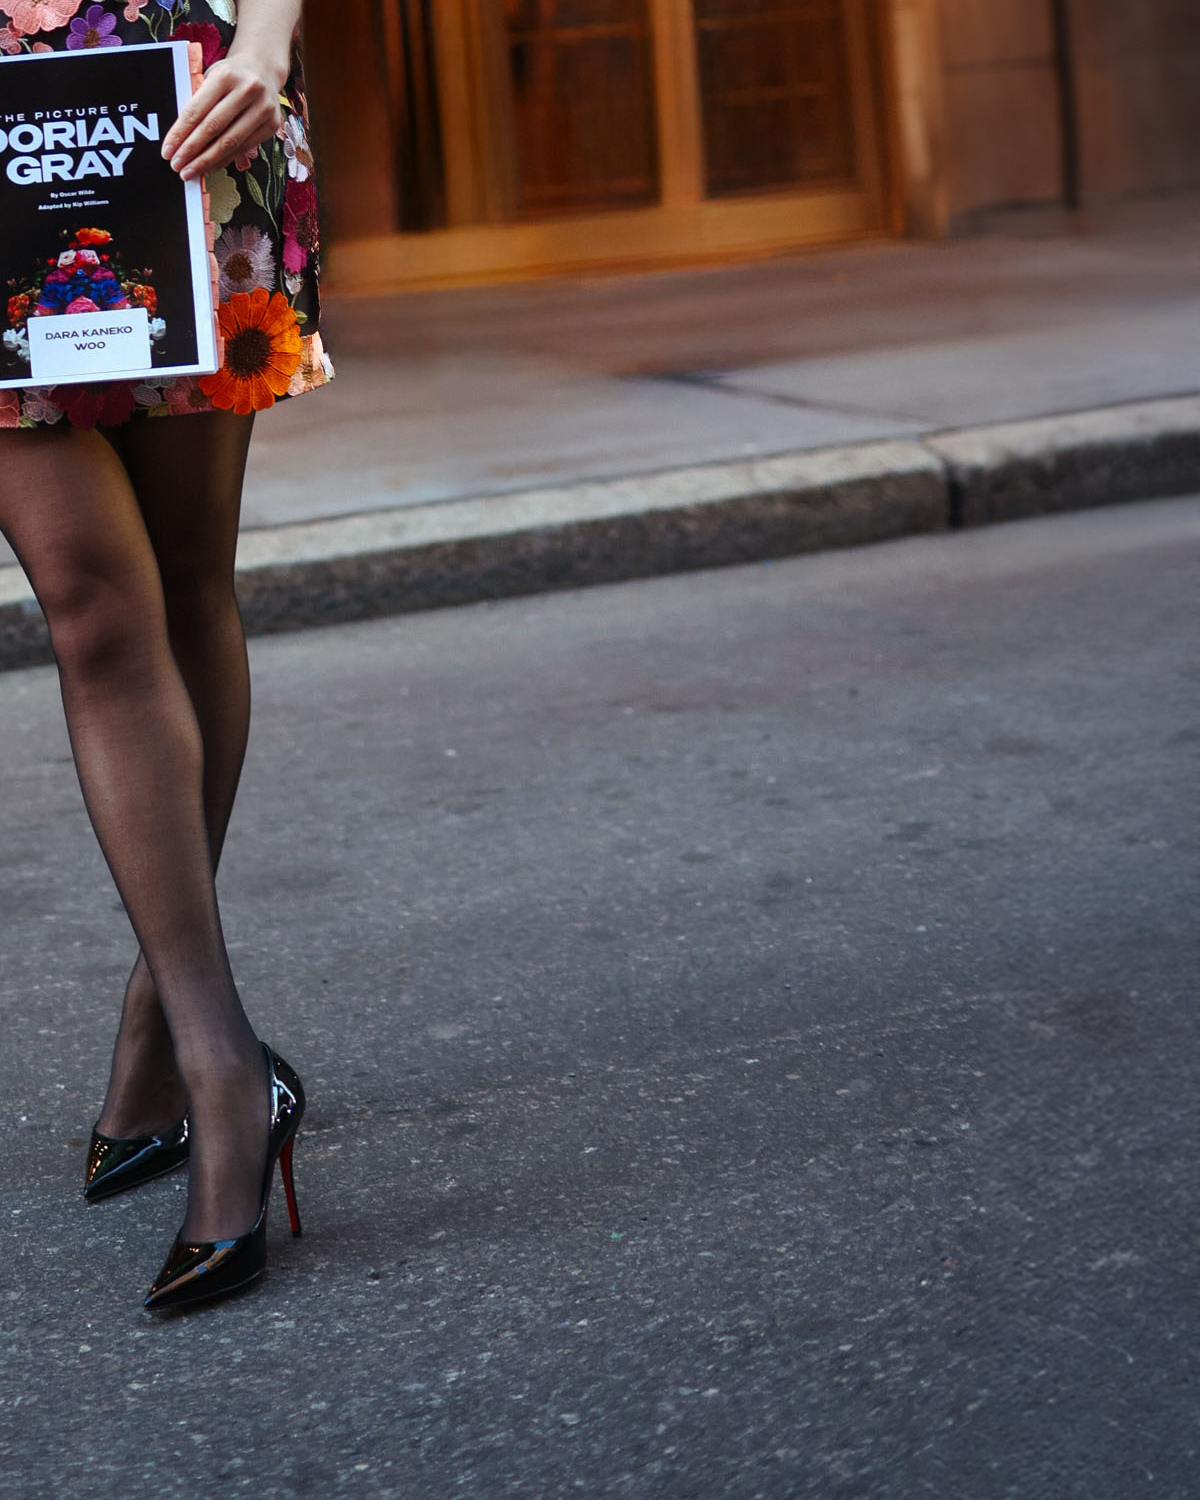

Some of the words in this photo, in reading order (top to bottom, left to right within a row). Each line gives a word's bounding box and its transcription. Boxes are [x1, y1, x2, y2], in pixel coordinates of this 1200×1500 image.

[34, 105, 109, 120] PICTURE
[117, 103, 139, 113] OF
[6, 147, 133, 185] GRAY
[37, 203, 63, 211] Adapted
[83, 199, 109, 207] Williams
[45, 330, 80, 340] DARA
[82, 325, 133, 338] KANEKO
[74, 341, 106, 351] WOO
